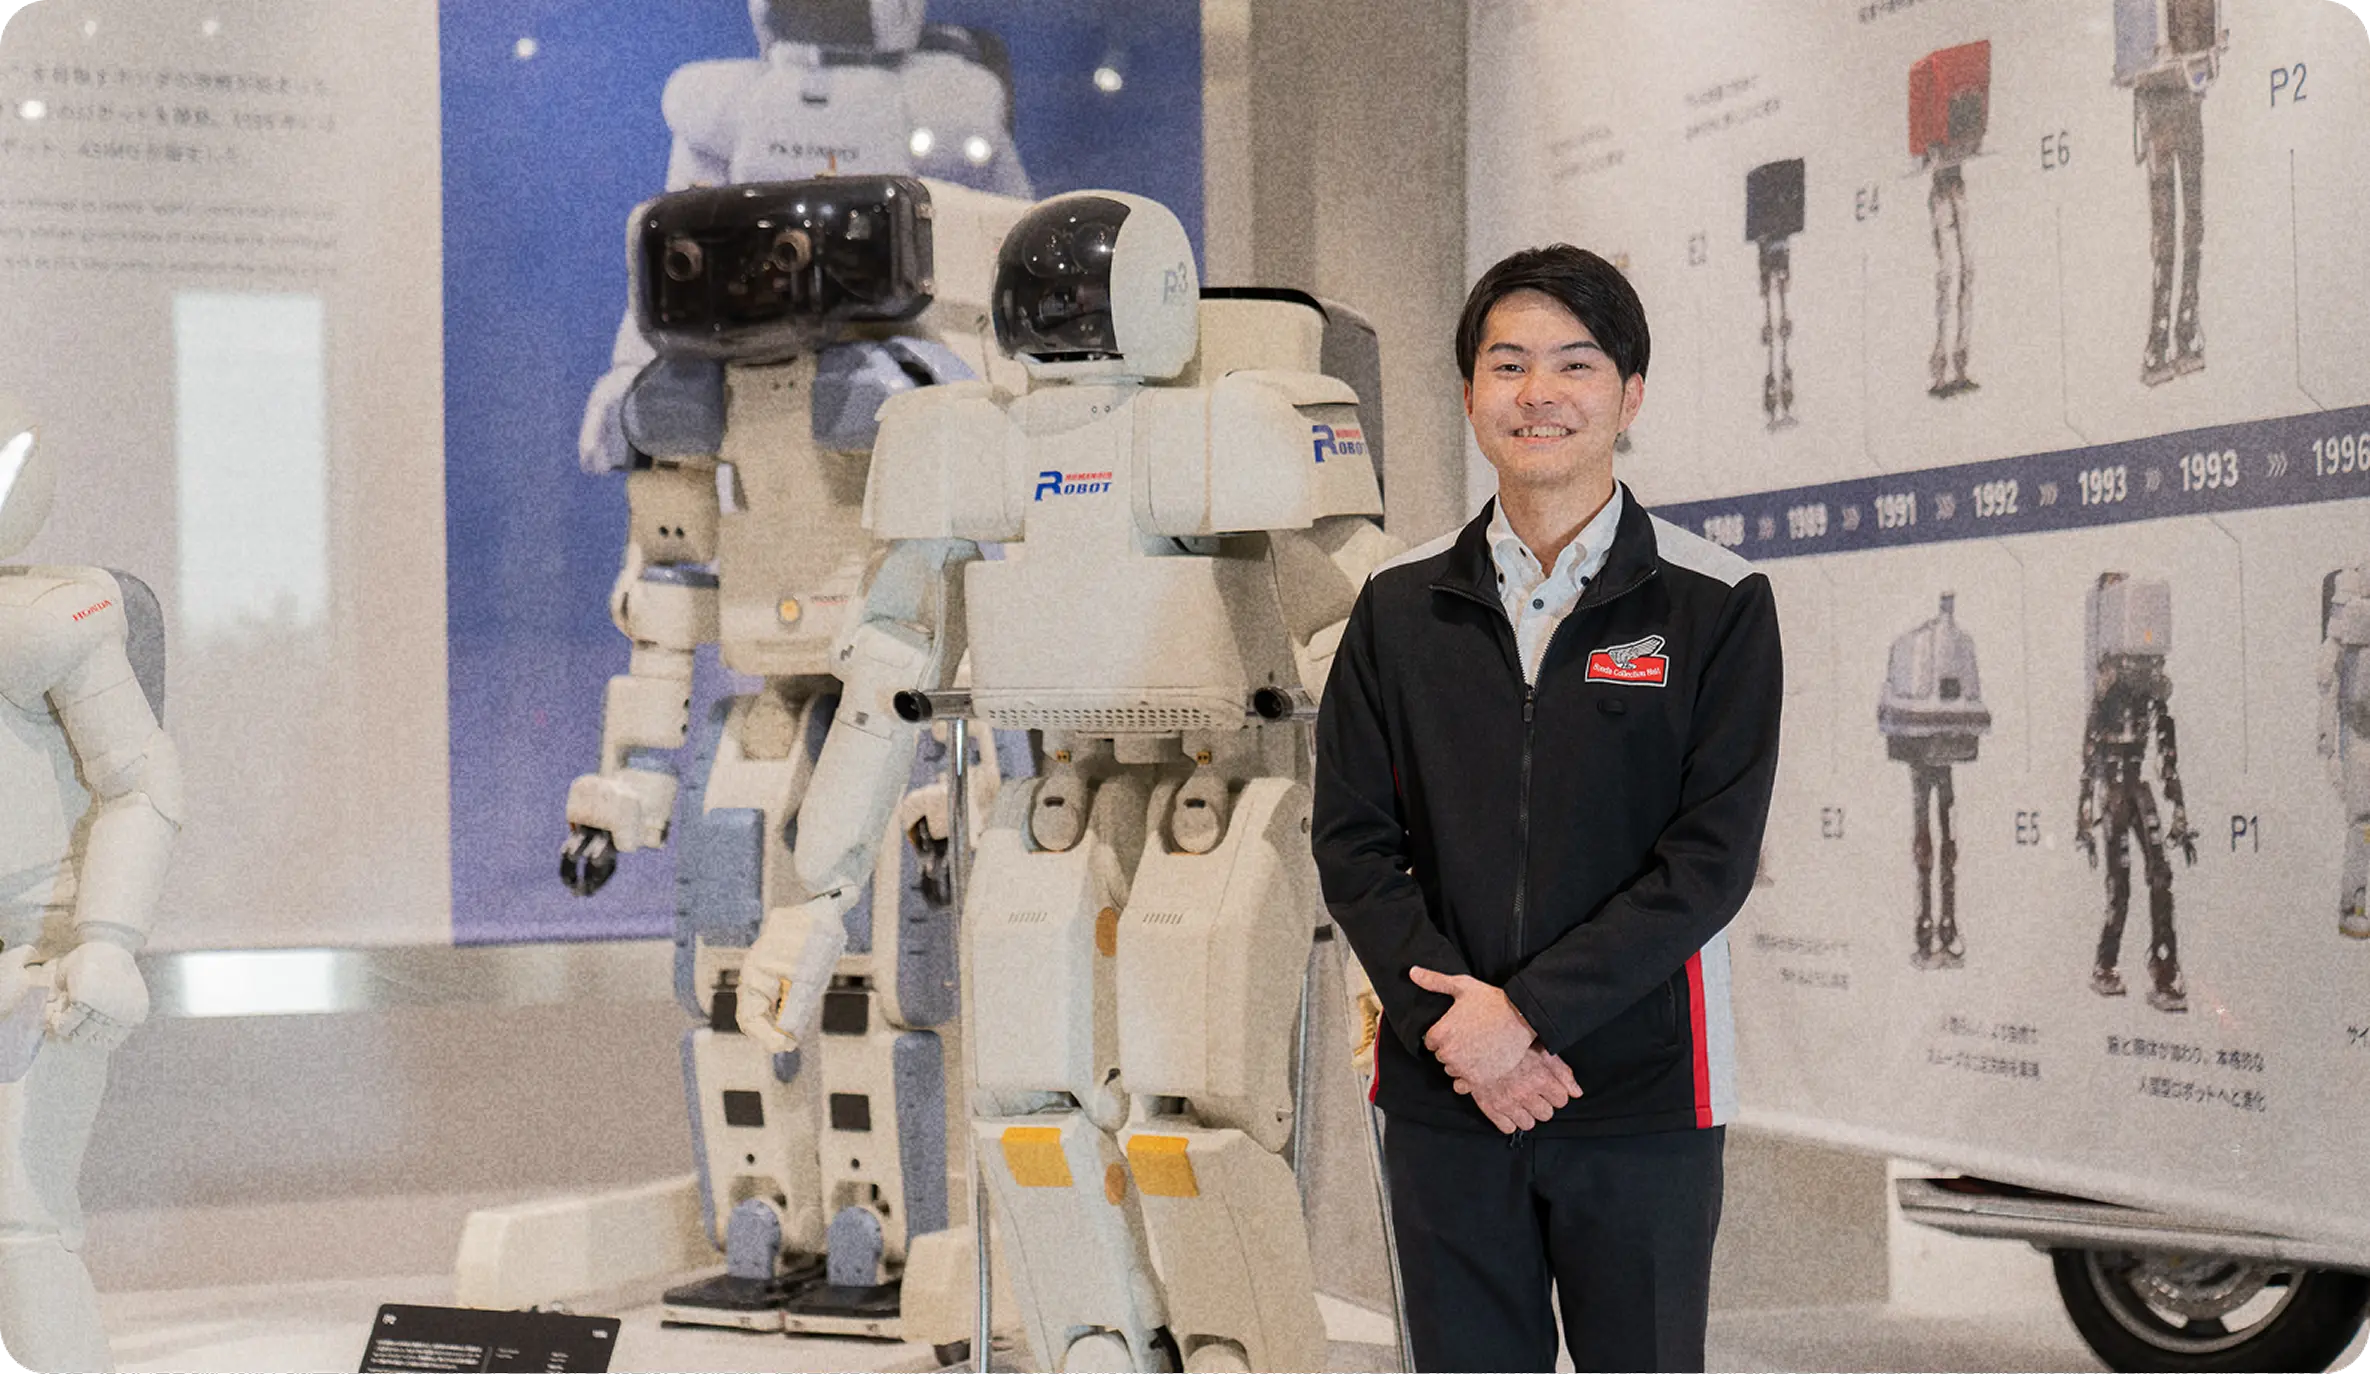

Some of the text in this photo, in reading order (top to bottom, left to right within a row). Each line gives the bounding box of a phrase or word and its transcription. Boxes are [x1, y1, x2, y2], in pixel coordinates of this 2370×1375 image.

[2270, 62, 2307, 108] P2
[2041, 131, 2070, 170] E6
[1855, 185, 1880, 223] E4
[1163, 261, 1188, 305] P3
[1034, 470, 1112, 502] ROBOT
[1875, 491, 1917, 530] 1991
[1972, 478, 2018, 518] 1992
[2078, 464, 2127, 505] 1993
[2179, 449, 2239, 492] 1993
[2312, 431, 2370, 477] 1996
[72, 599, 113, 621] HONDA
[2230, 815, 2258, 853] P1
